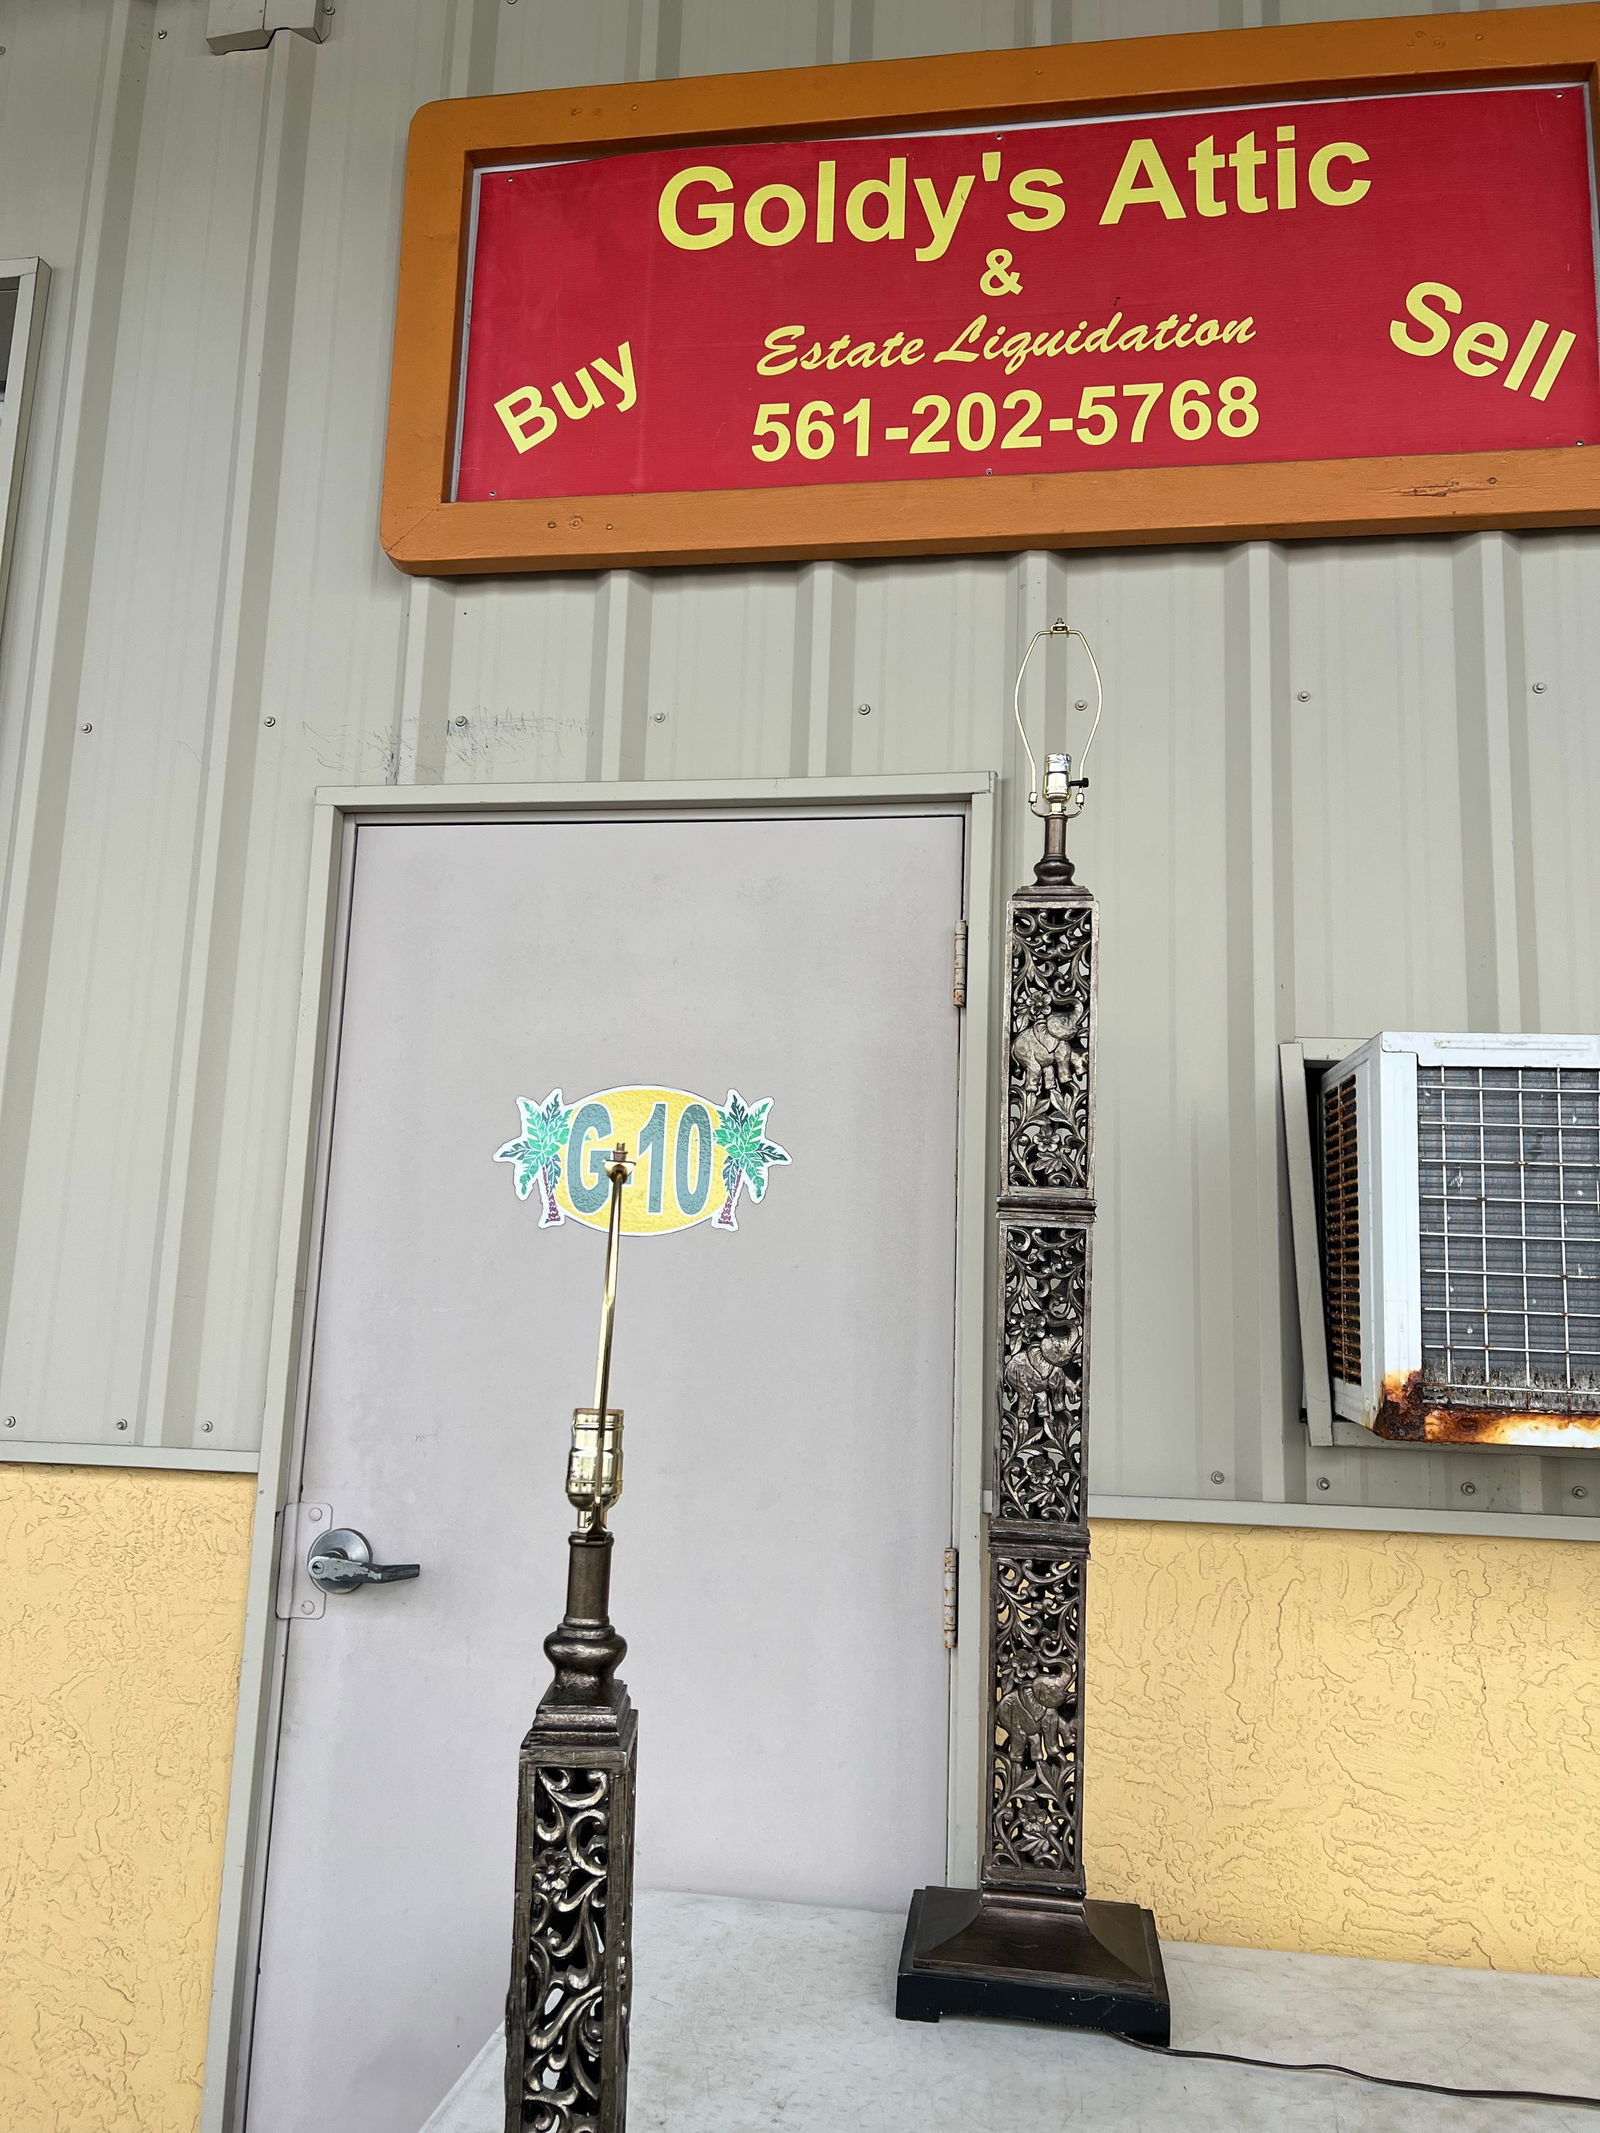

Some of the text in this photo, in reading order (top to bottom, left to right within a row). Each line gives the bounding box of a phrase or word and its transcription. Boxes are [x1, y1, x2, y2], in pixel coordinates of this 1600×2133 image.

[658, 125, 1372, 262] Goldy's Attic
[979, 248, 1024, 297] &
[494, 341, 637, 454] Buy
[756, 311, 1257, 376] Estate Liquidation
[1389, 281, 1577, 401] Sell
[751, 376, 1260, 462] 561-202-5768
[567, 1102, 713, 1216] G10
